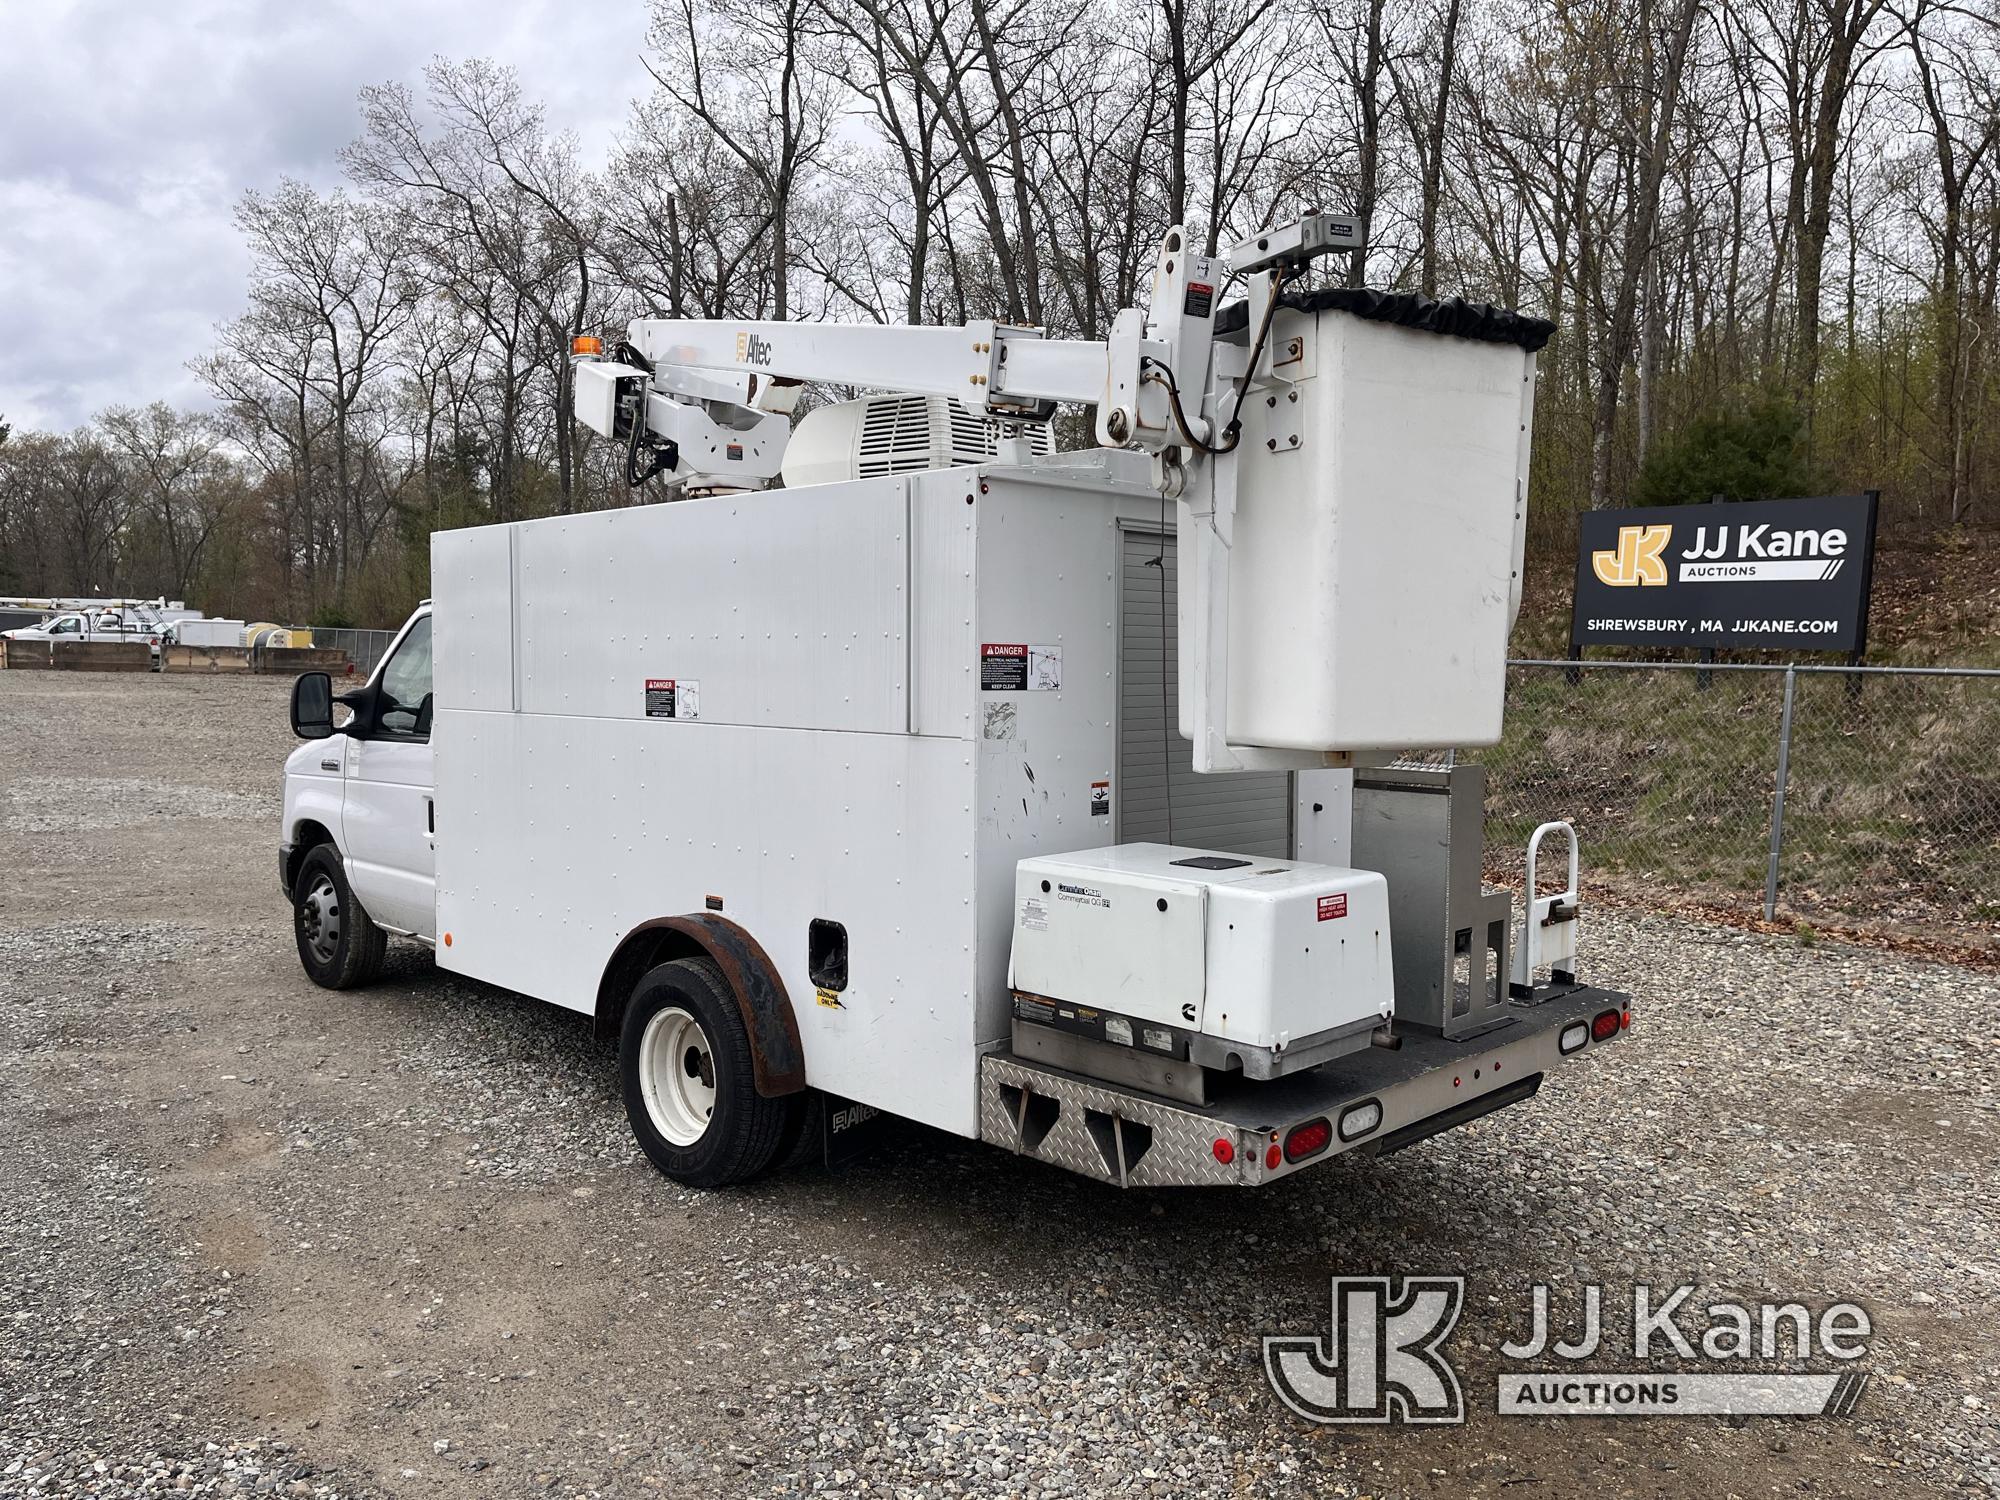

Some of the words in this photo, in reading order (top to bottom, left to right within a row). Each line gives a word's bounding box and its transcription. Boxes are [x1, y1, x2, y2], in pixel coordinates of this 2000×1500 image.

[746, 334, 772, 366] Altec
[1681, 526, 1729, 560] JJ
[1738, 523, 1847, 558] Kane
[1687, 566, 1757, 577] AUCTIONS
[1587, 619, 1687, 633] SHREWSBURY
[1700, 620, 1723, 632] MA
[1731, 620, 1838, 633] JJKANE.COM
[994, 646, 1022, 655] DANGER
[653, 681, 672, 689] DANGER
